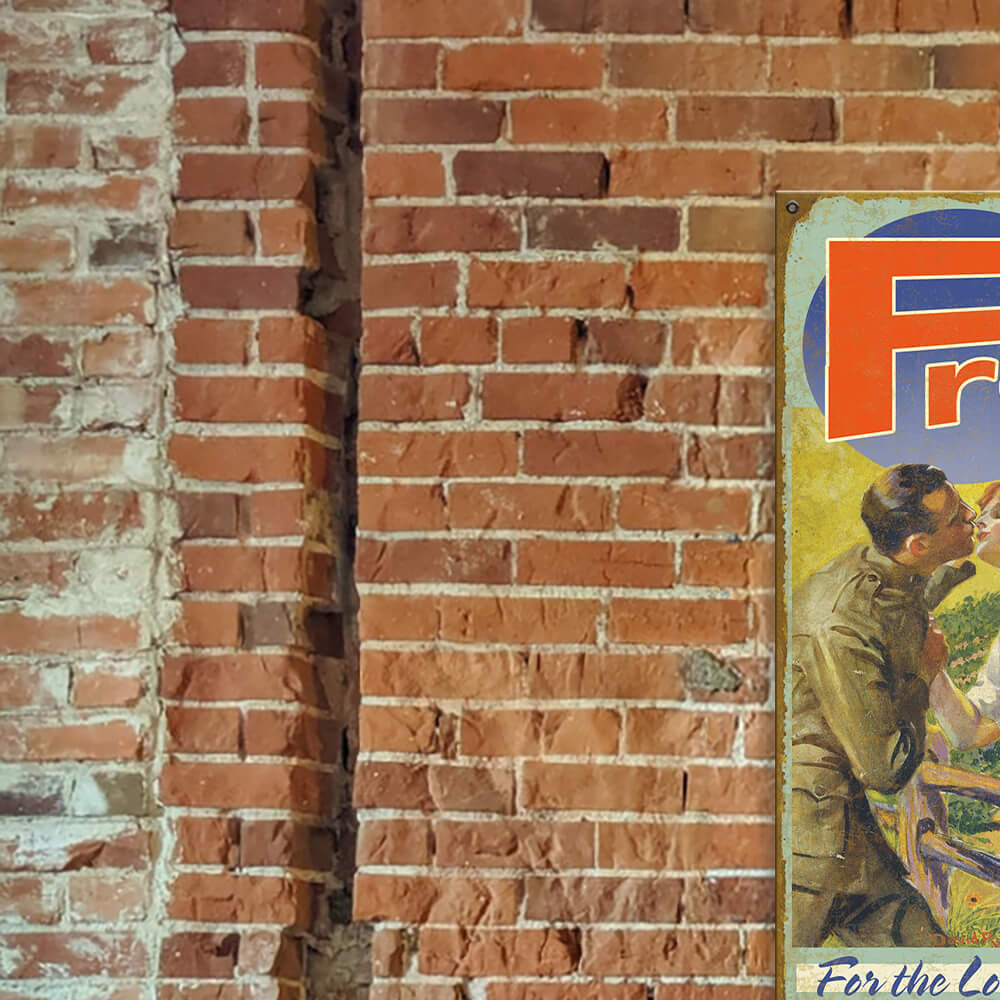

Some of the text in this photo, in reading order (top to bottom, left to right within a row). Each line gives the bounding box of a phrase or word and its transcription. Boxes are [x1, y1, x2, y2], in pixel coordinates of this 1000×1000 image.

[931, 930, 977, 946] David
[817, 956, 886, 997] For
[891, 960, 950, 997] the
